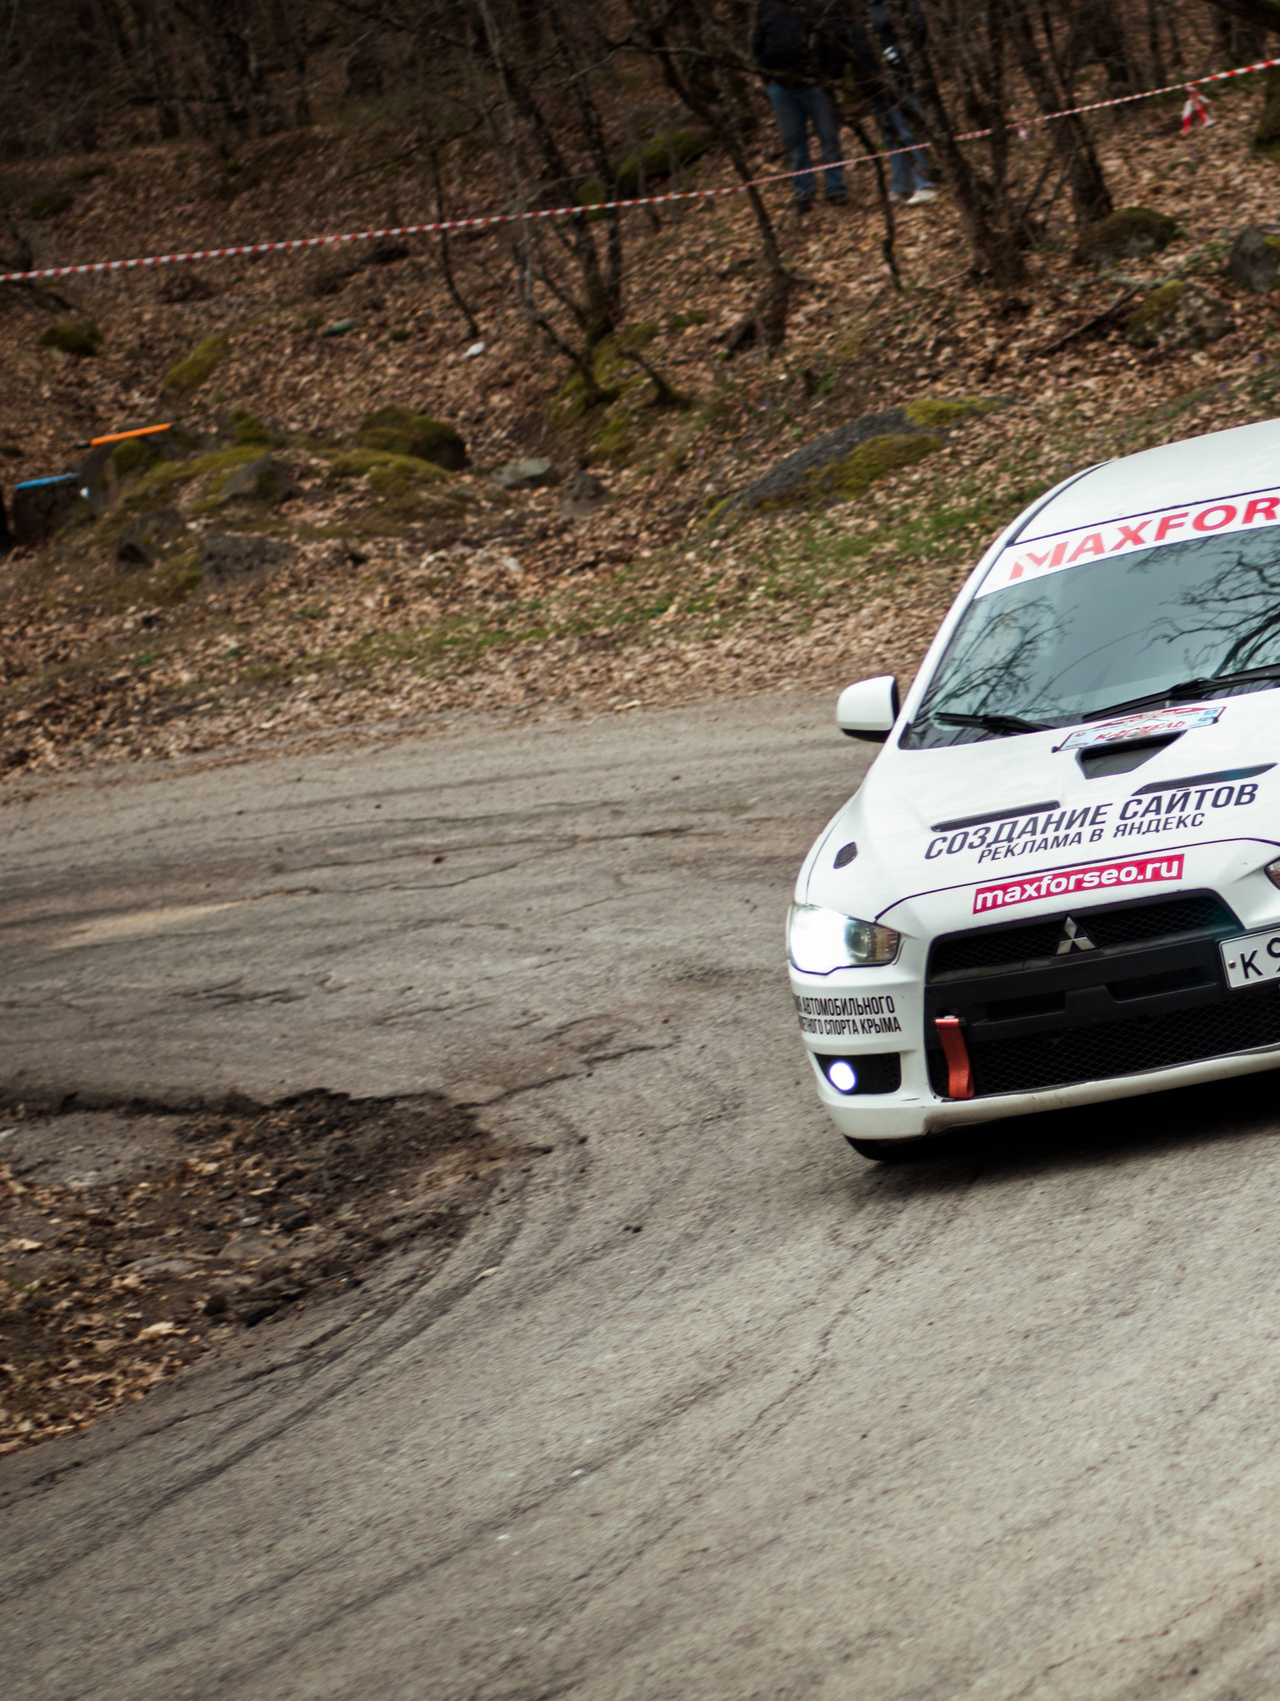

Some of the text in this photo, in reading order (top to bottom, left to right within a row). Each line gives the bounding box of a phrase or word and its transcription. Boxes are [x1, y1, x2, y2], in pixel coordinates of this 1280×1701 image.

[925, 784, 1258, 859] СОЗДАНИЕ САЙТОВ
[978, 813, 1205, 863] РЕКЛАМА В ЯНДЕКС
[976, 861, 1179, 910] maxforseo.ru
[802, 995, 895, 1016] АВТОМОБИЛЬНОГО
[824, 1019, 859, 1035] СПОРТА
[860, 1016, 902, 1034] КРЫМА
